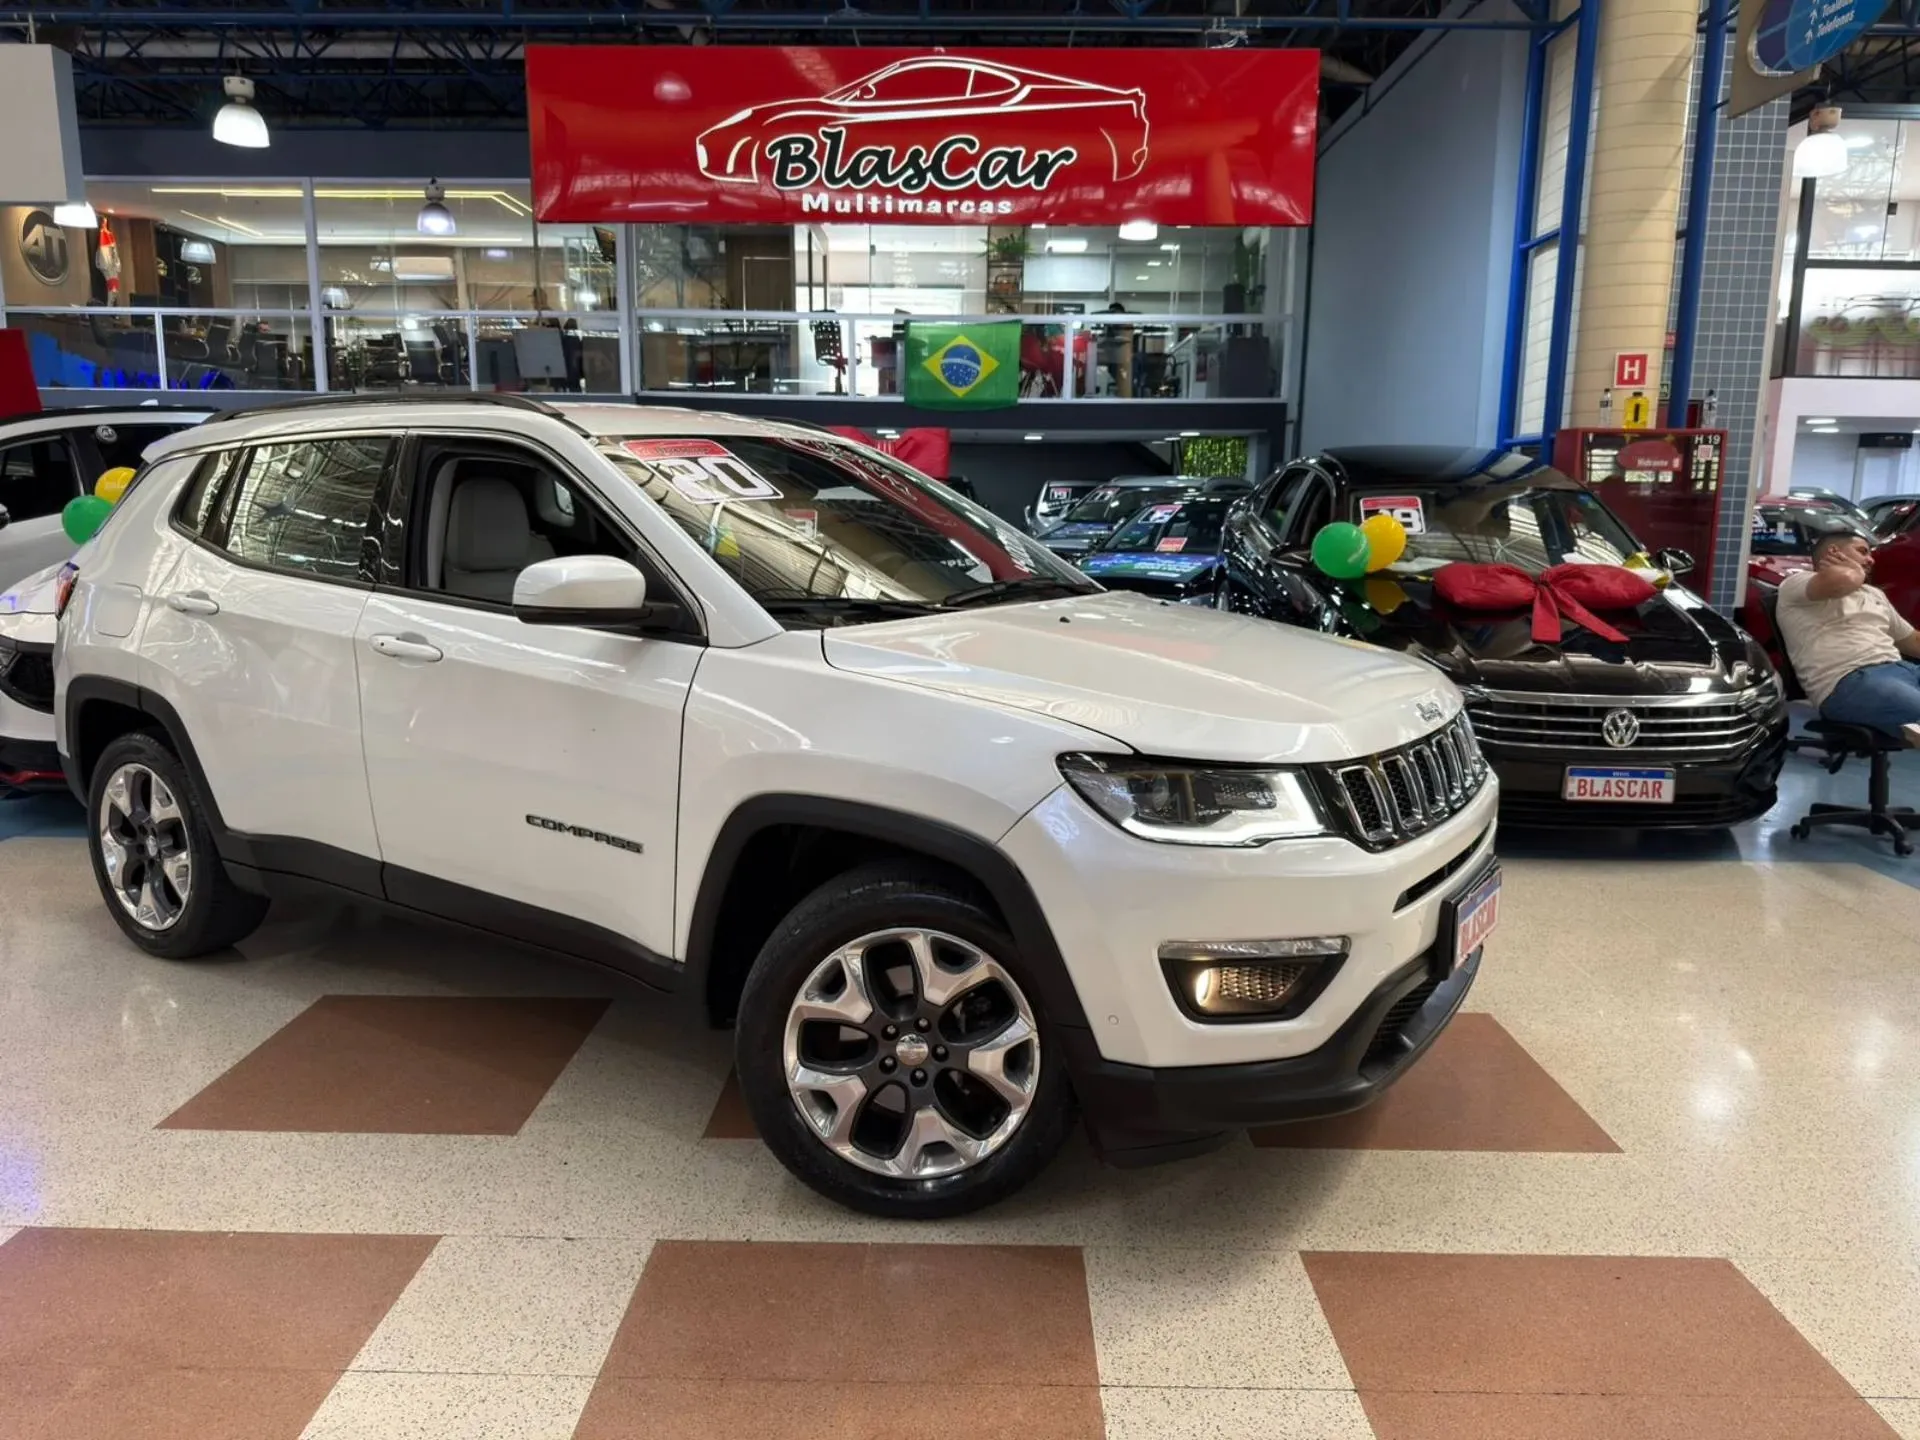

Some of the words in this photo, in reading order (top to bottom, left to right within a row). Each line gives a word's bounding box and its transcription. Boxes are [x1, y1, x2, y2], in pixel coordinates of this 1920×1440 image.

[766, 127, 1077, 193] BlasCar
[801, 193, 1013, 214] Multimarcas
[1622, 359, 1641, 381] H
[647, 456, 775, 501] 20
[1576, 778, 1663, 800] BLASCAR
[525, 813, 645, 854] COMPASS
